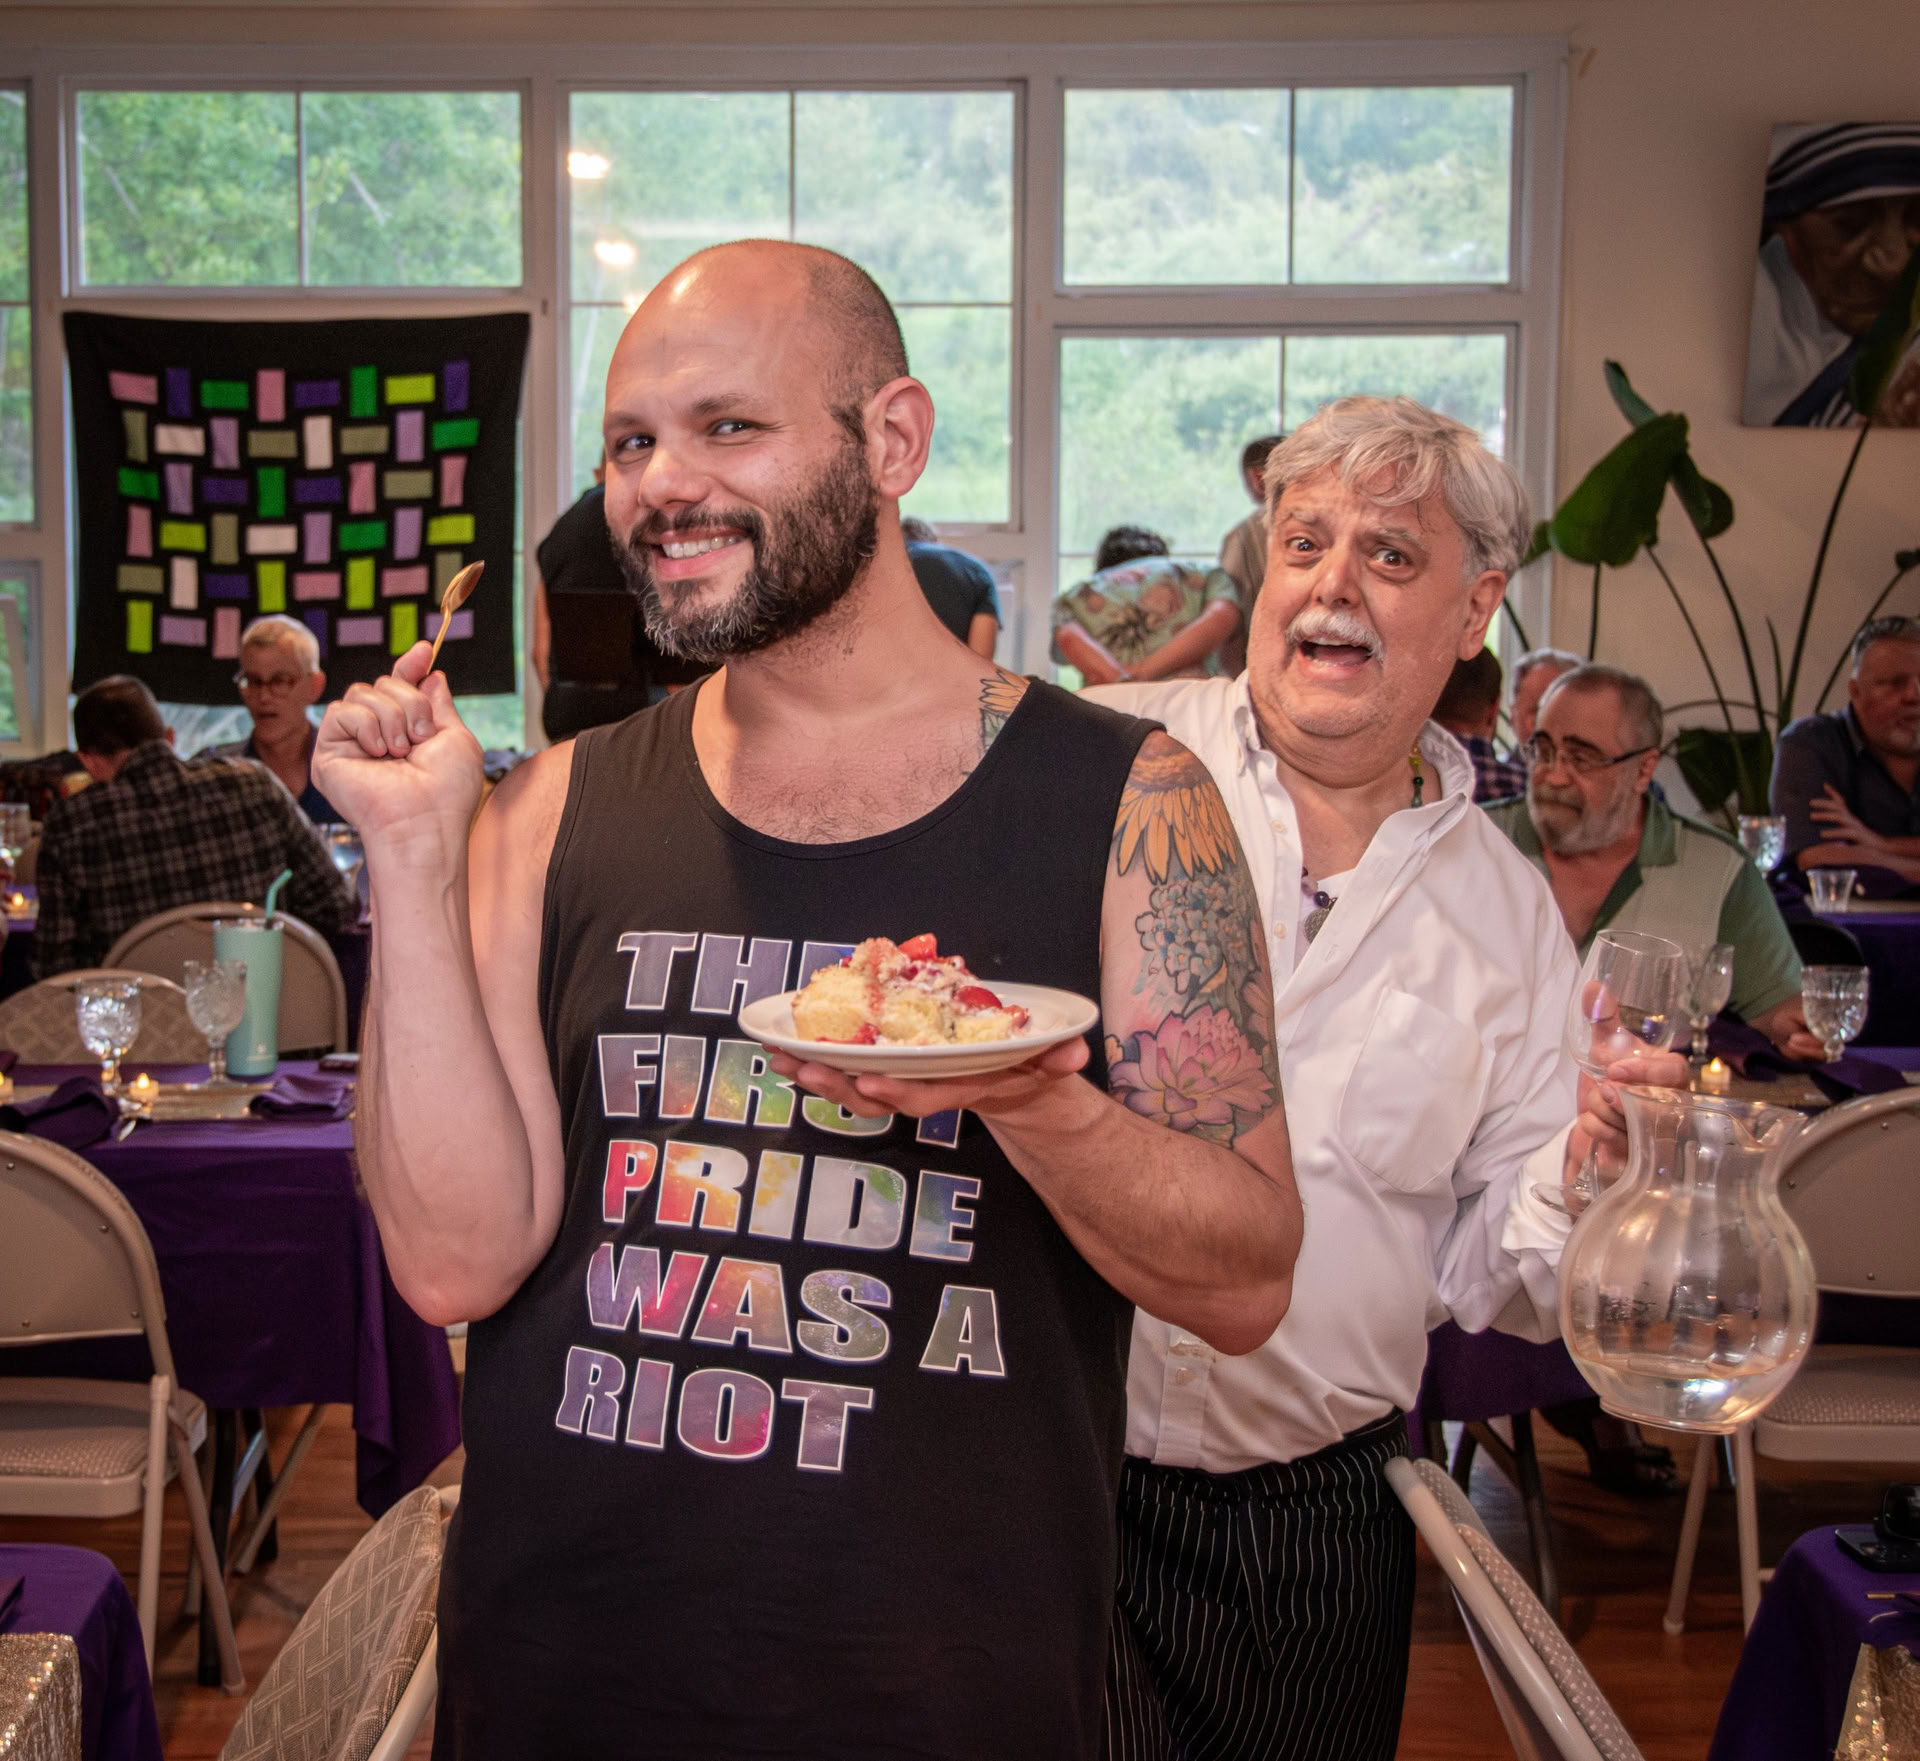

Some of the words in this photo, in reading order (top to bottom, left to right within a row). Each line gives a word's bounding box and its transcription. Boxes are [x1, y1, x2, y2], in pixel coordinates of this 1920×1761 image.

[602, 1139, 982, 1263] PRIDE
[586, 1242, 892, 1363] WAS
[918, 1284, 1006, 1378] A
[555, 1346, 875, 1473] RIOT
